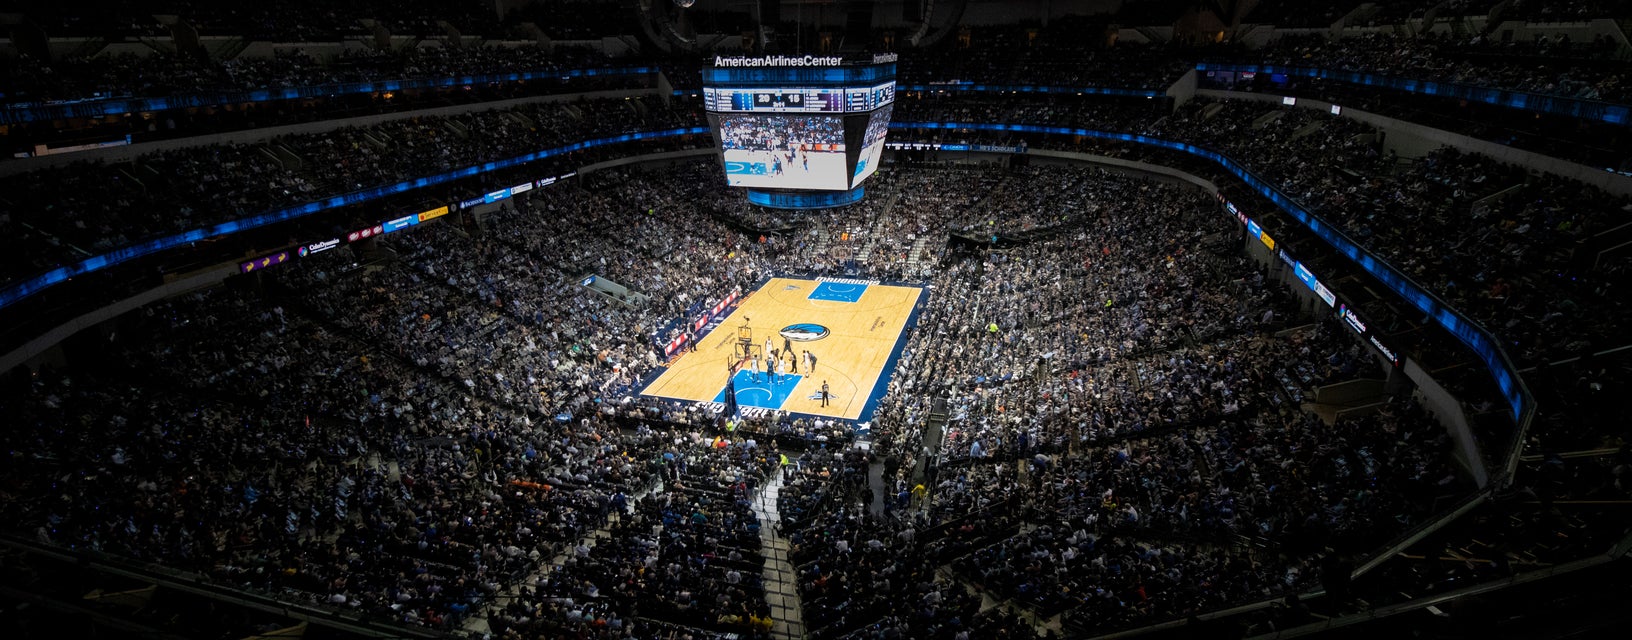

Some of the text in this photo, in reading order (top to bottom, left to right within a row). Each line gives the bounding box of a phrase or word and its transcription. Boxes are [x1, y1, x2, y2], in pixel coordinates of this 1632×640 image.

[715, 55, 842, 67] AmericanAirlinesCenter
[758, 94, 770, 103] 20
[788, 94, 800, 103] 15
